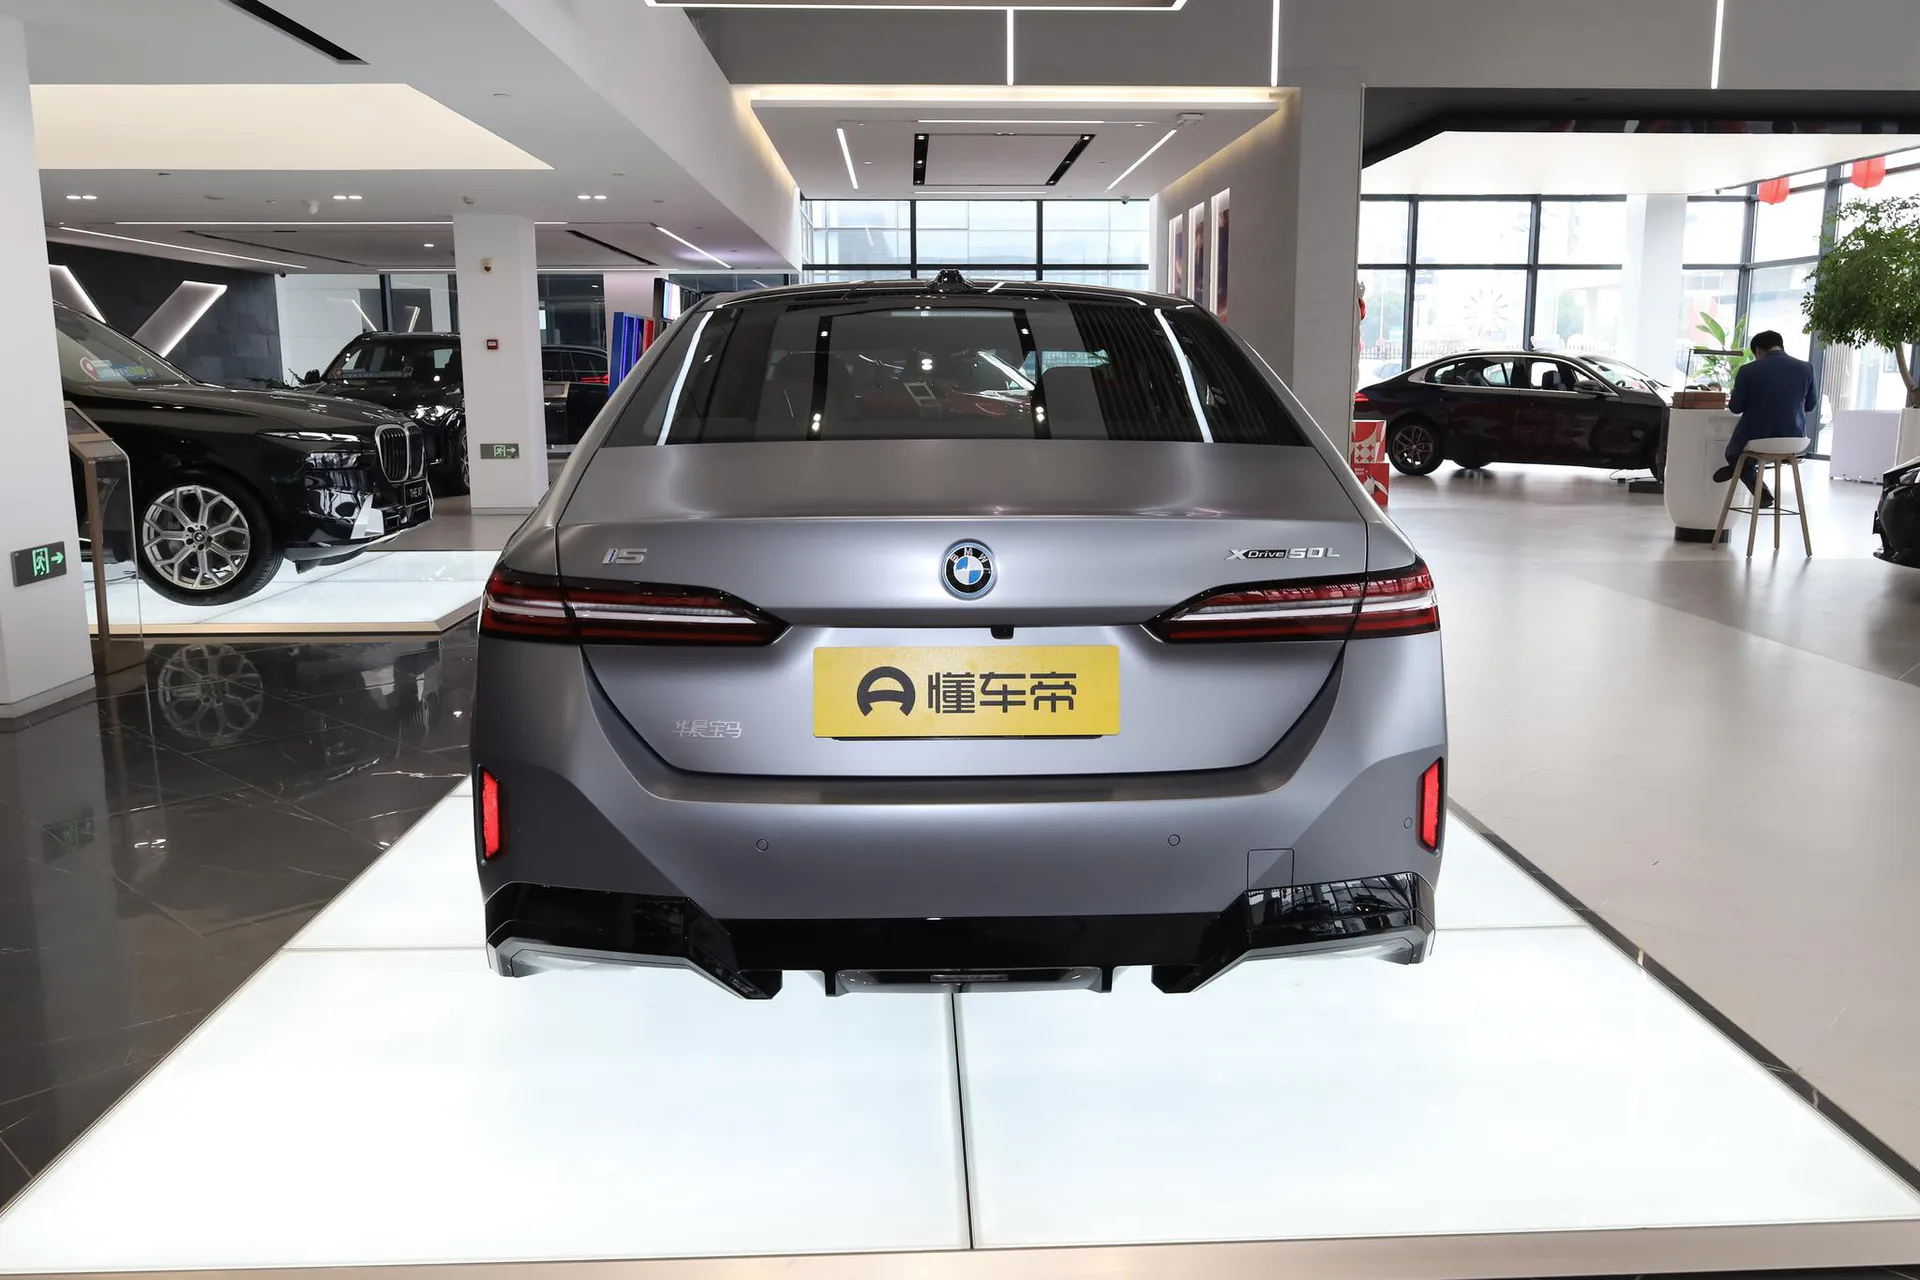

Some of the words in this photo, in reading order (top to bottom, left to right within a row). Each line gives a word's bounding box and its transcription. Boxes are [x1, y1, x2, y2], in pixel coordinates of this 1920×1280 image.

[950, 547, 988, 563] BMW
[927, 671, 1077, 714] 懂车帝
[674, 719, 742, 739] 华晨宝马
